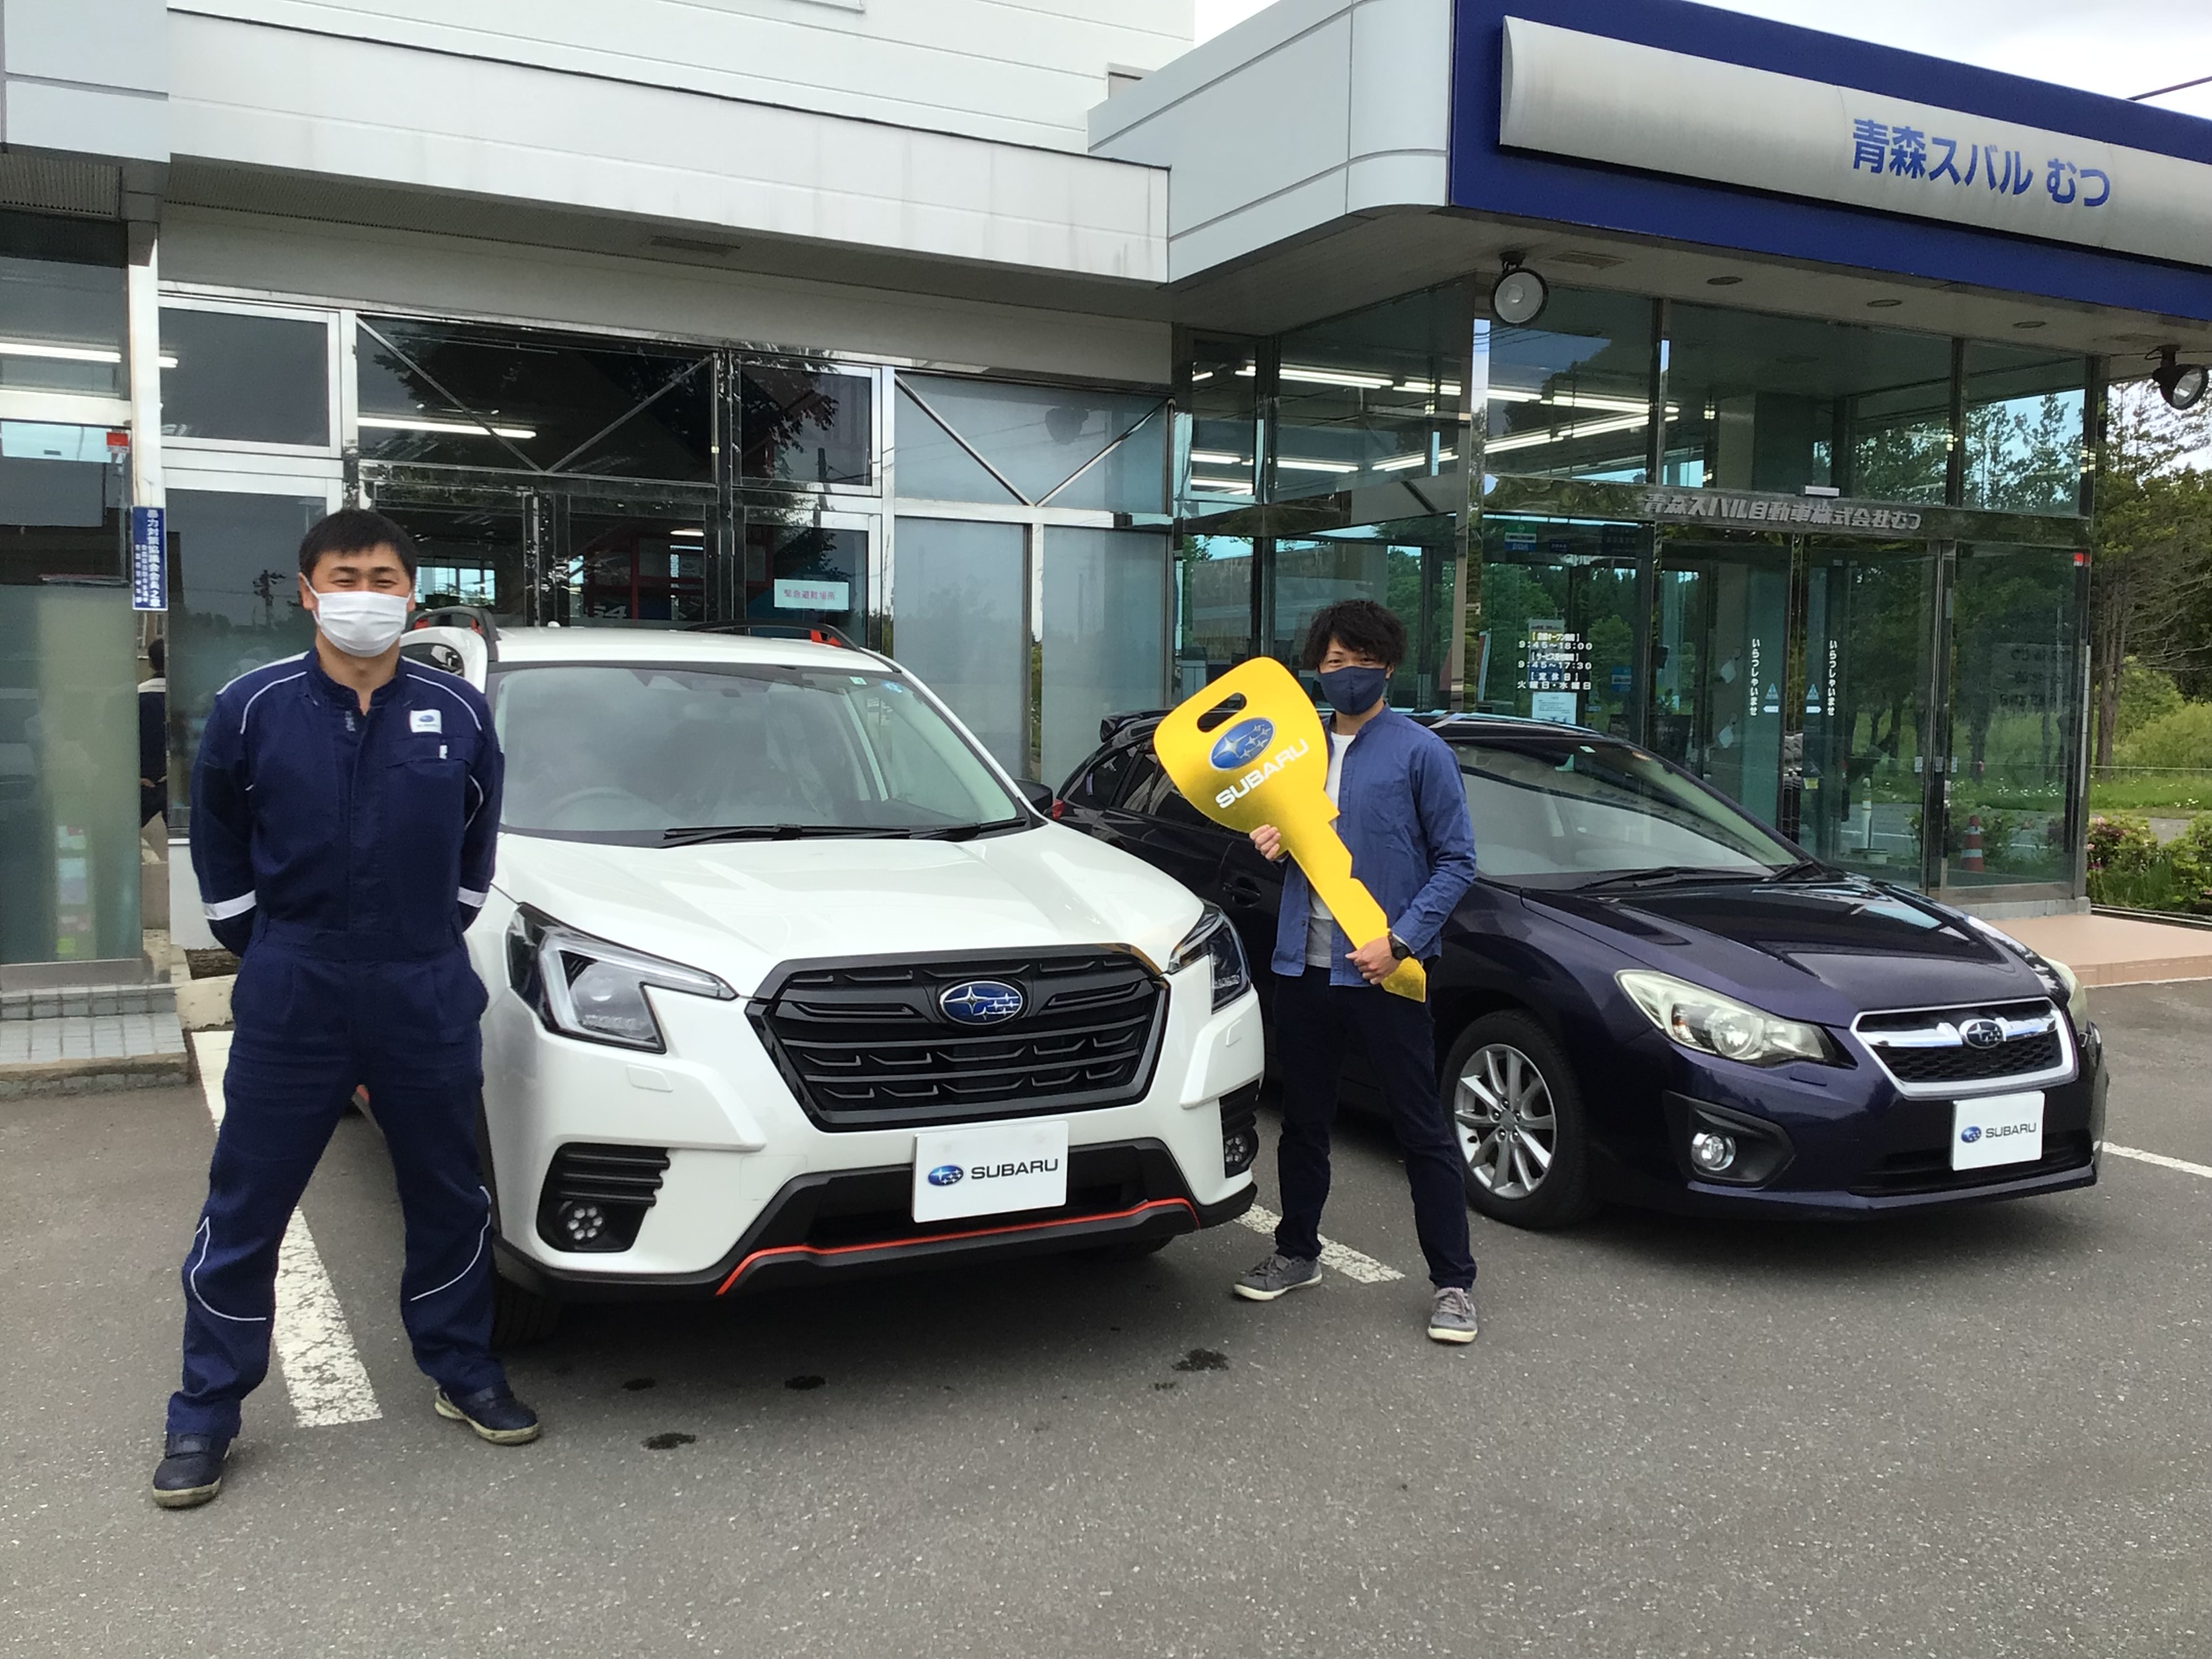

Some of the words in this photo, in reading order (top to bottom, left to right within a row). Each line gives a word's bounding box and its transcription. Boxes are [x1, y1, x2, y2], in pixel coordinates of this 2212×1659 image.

[1853, 119, 2033, 195] 青森スバル
[2046, 158, 2110, 207] むつ
[1644, 494, 1921, 531] 青森スバル自動車株式会社むつ
[1215, 738, 1309, 809] SUBARU
[1986, 1122, 2036, 1139] SUBARU
[971, 1158, 1058, 1180] SUBARU
